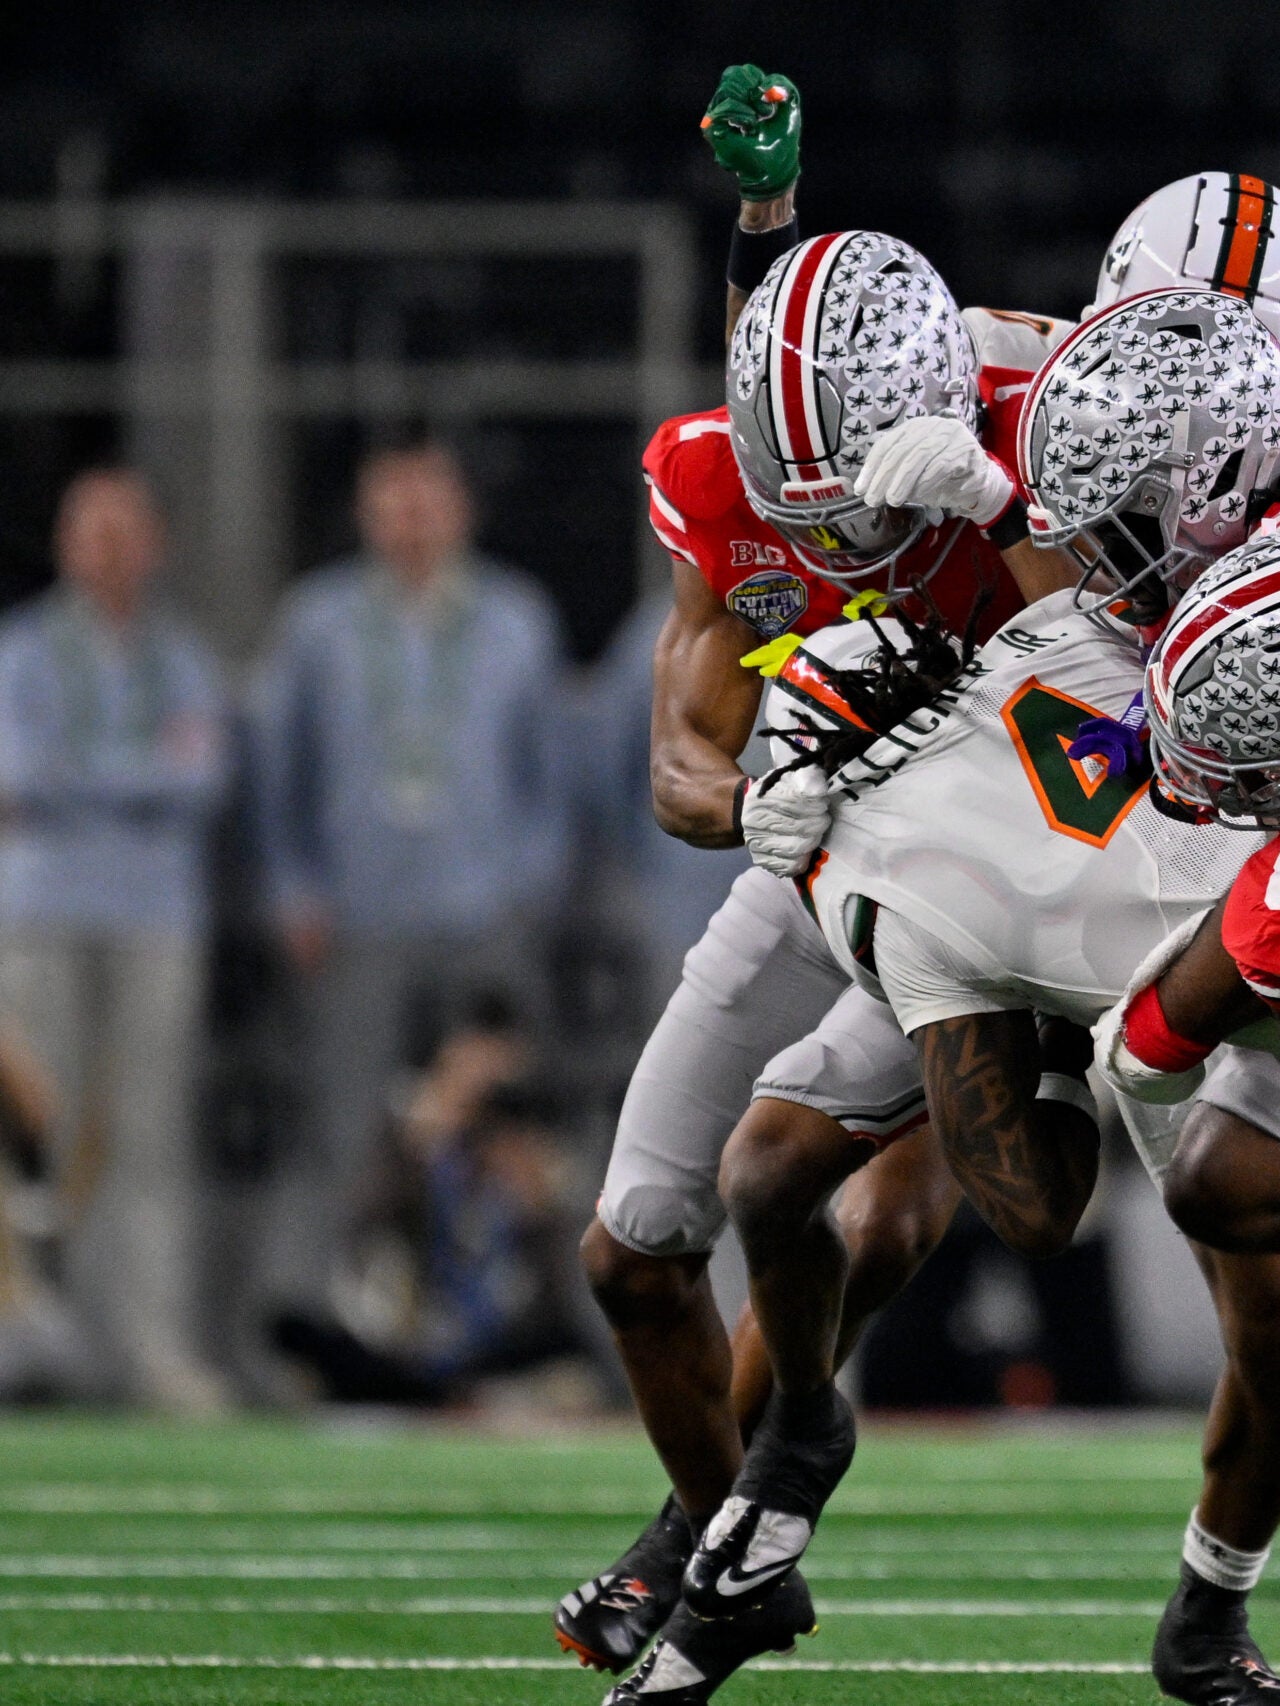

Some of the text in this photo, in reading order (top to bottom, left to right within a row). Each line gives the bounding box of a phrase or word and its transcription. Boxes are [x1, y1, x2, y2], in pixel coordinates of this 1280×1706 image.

[734, 589, 802, 612] COTTON
[996, 628, 1069, 659] JR.
[1000, 675, 1152, 850] 4
